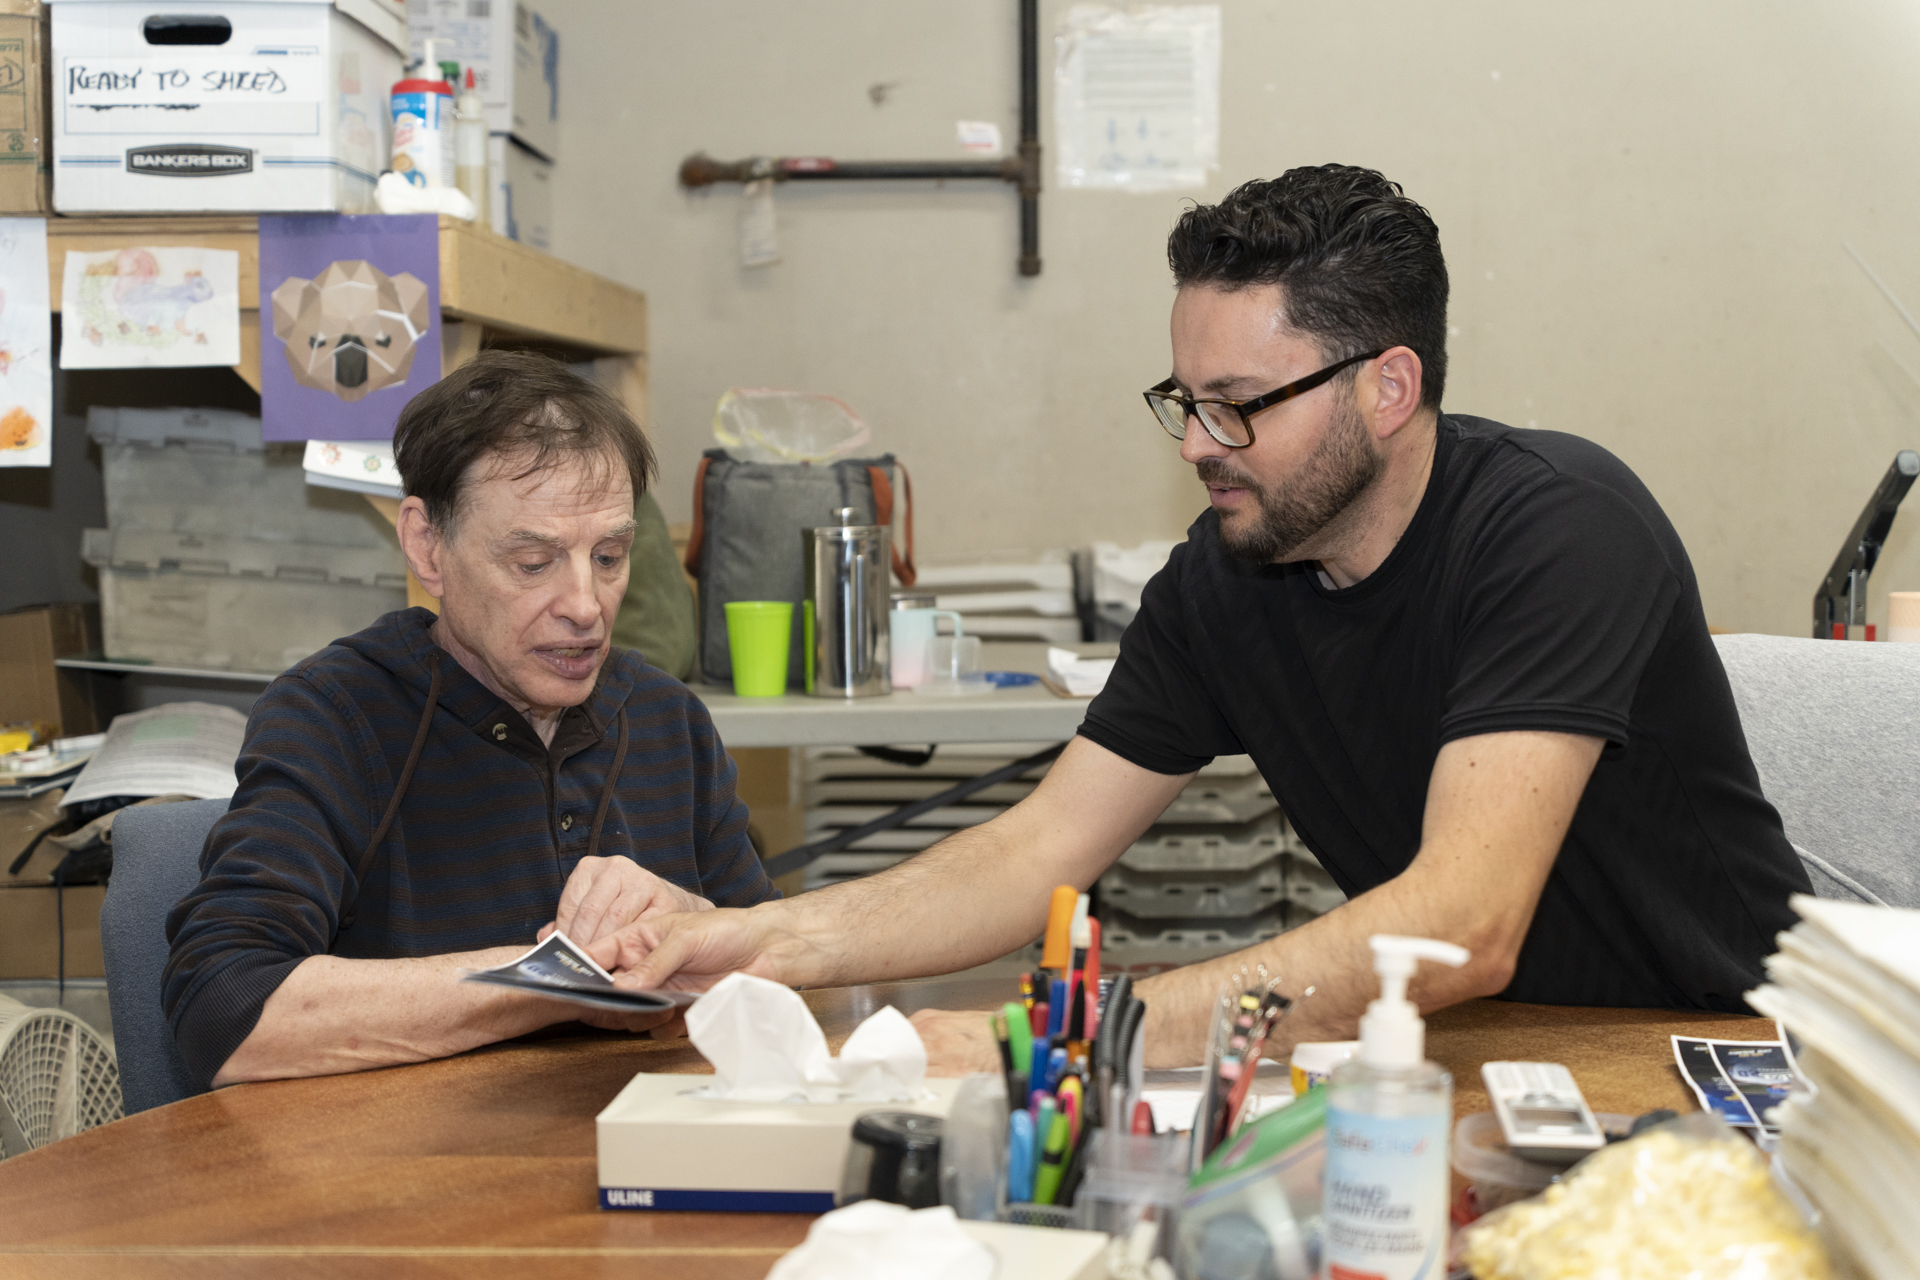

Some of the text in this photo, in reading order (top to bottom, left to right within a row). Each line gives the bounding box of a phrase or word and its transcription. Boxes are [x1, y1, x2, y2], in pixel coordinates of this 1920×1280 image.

[70, 67, 287, 94] READY TO SHRED
[132, 153, 247, 168] BANKERS BOX
[607, 1189, 654, 1206] ULINE
